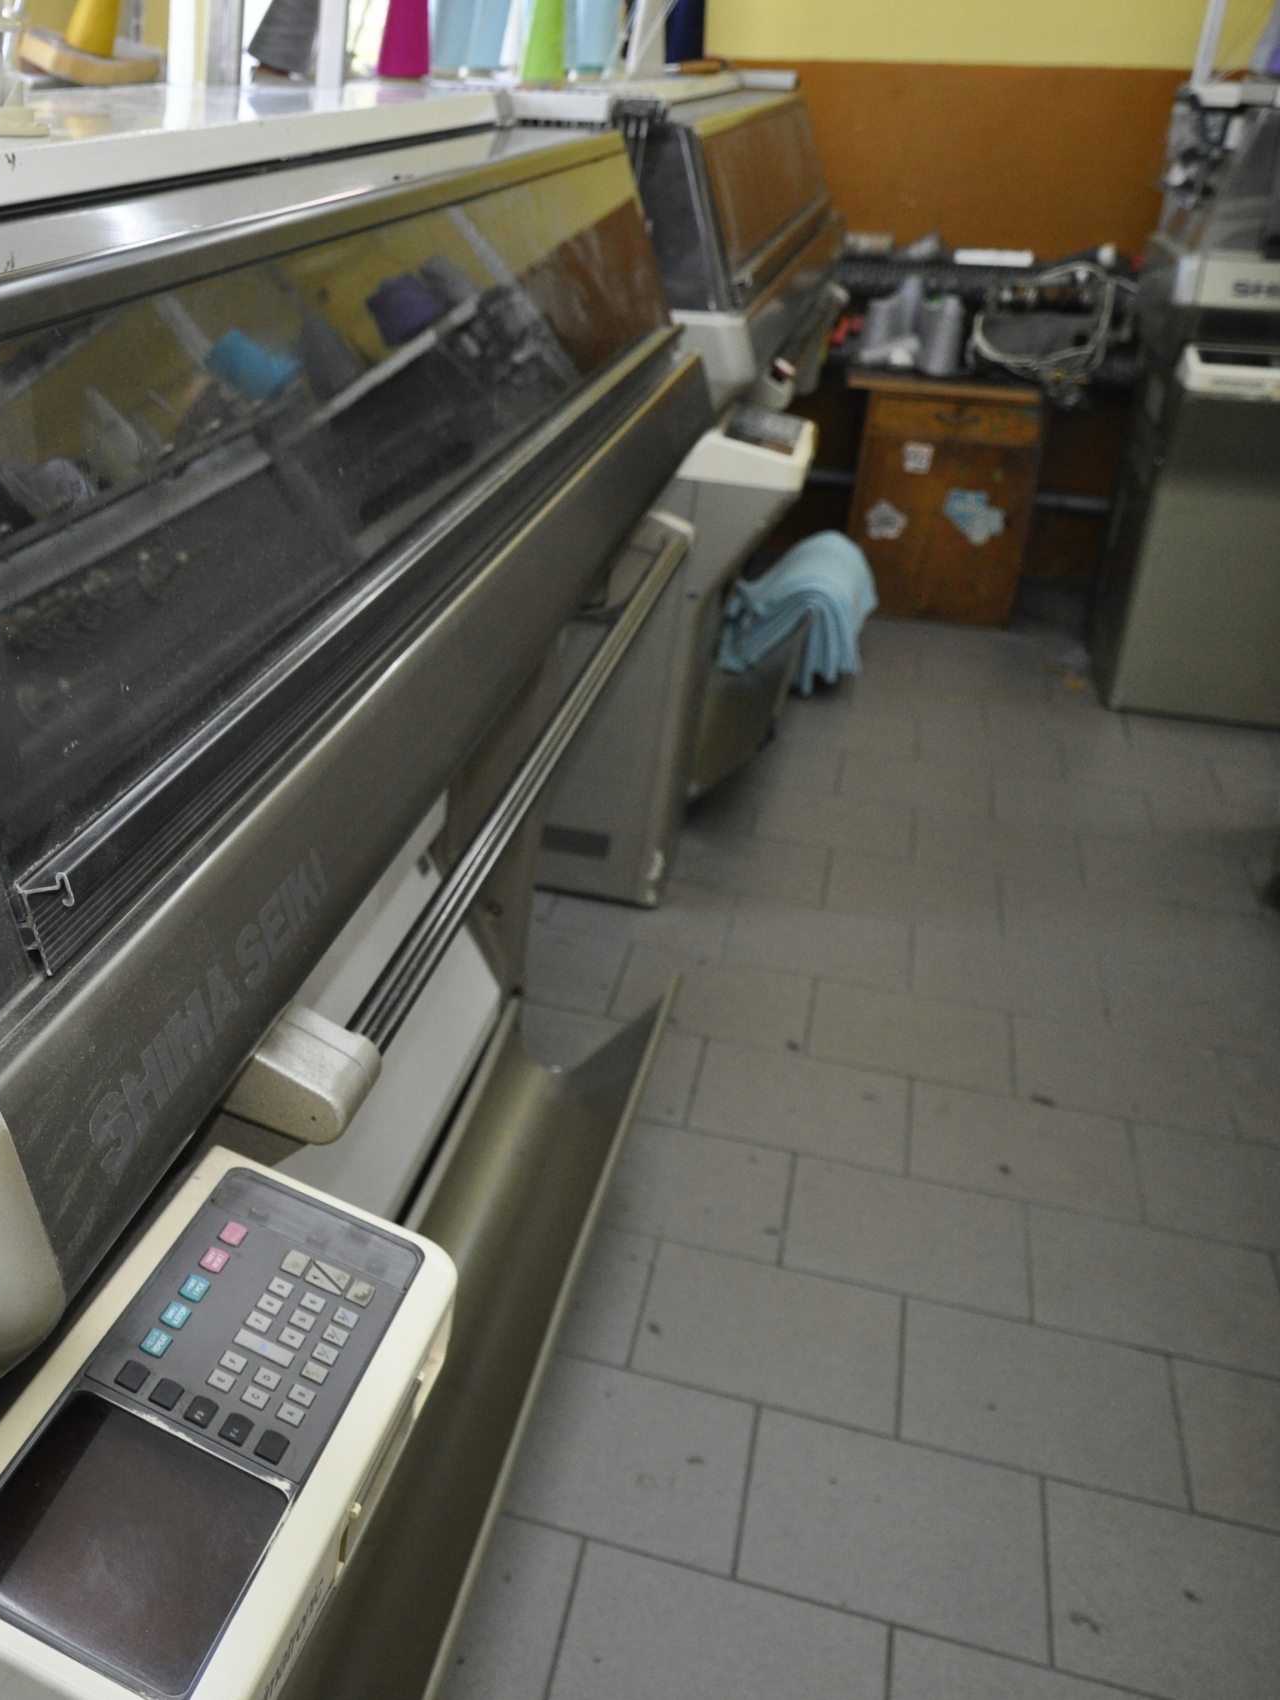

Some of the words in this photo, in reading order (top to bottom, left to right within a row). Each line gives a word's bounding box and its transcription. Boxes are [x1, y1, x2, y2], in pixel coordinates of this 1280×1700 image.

[89, 964, 241, 1173] SHIMA
[235, 848, 329, 988] SEIKI
[194, 1410, 205, 1421] F3
[229, 1427, 240, 1438] F4
